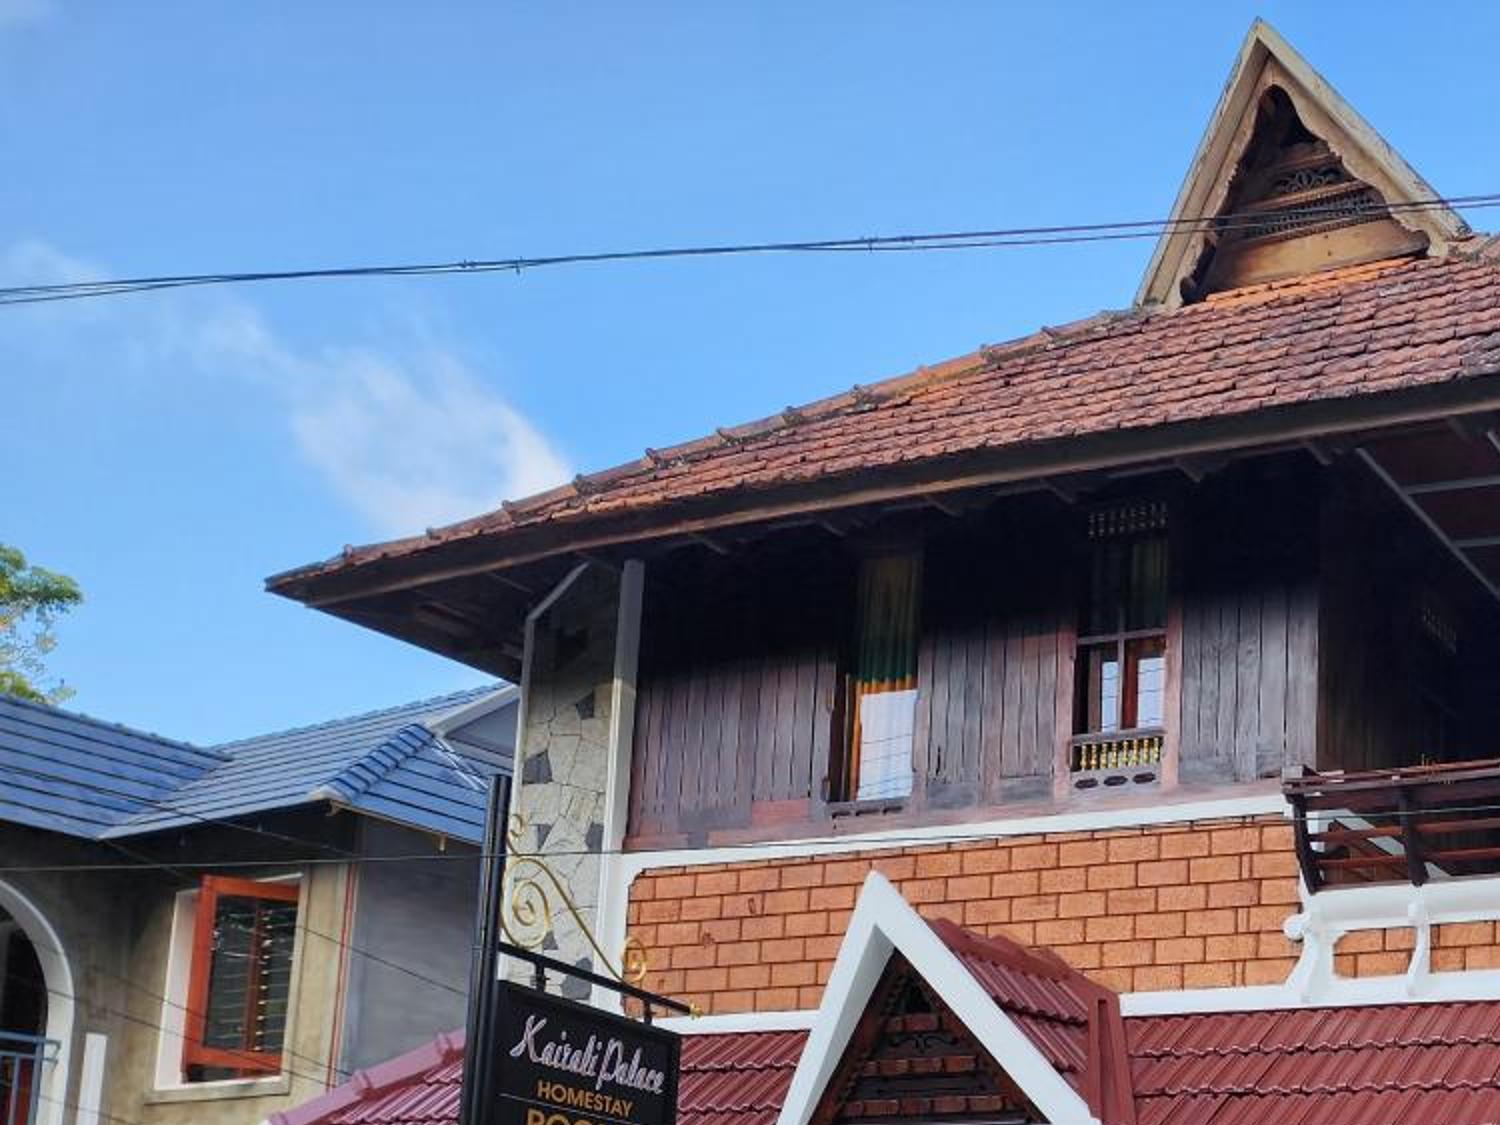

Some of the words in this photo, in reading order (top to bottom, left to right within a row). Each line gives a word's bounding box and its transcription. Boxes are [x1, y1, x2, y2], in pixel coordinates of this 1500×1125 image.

[510, 1014, 603, 1077] Kairali
[595, 1037, 665, 1095] Palace
[537, 1079, 634, 1118] HOMESTAY
